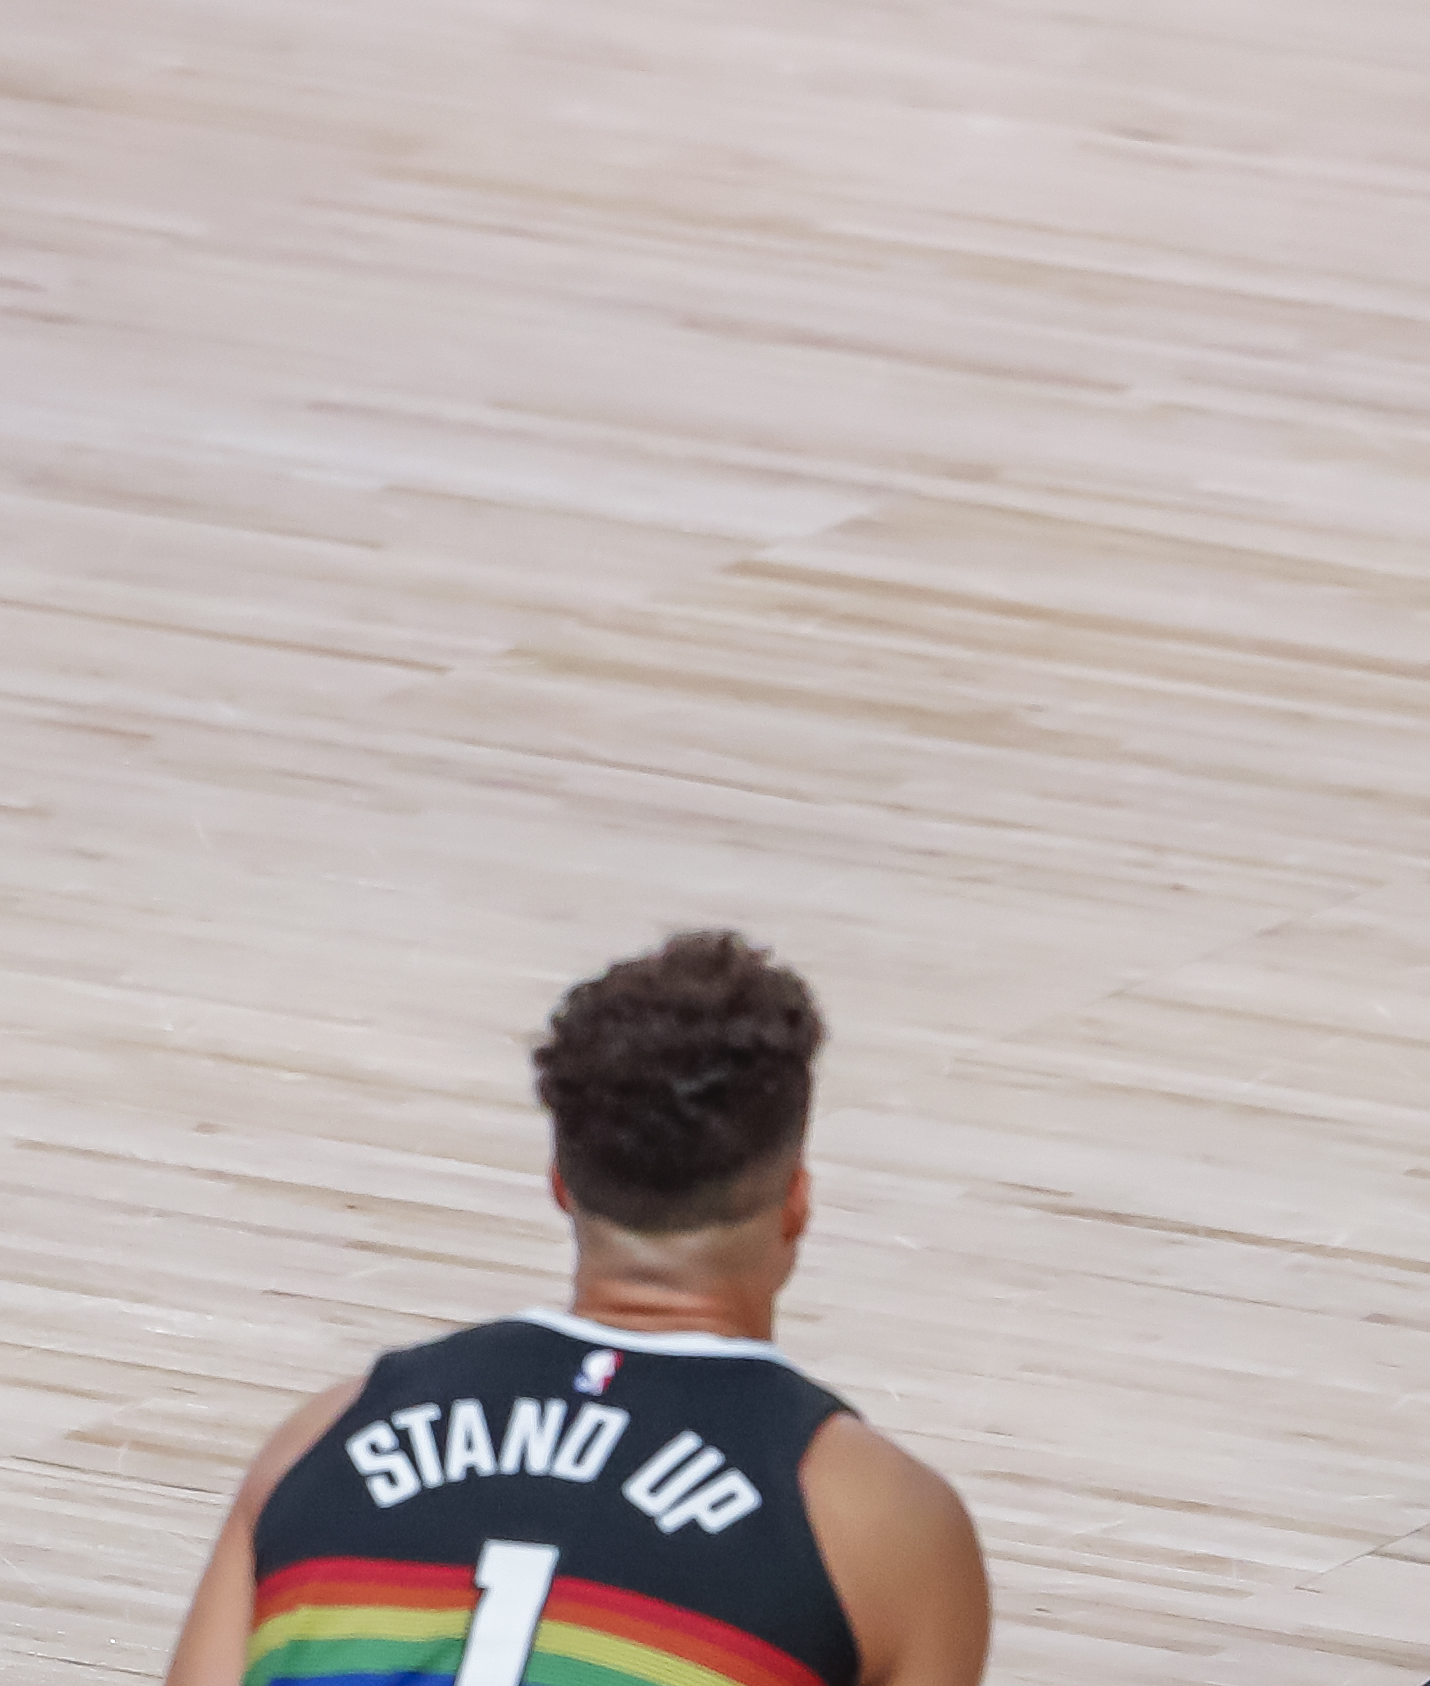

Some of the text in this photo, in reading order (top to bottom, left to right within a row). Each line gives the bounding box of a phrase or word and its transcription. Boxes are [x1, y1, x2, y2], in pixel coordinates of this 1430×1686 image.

[345, 1396, 764, 1537] STAND UP
[454, 1537, 560, 1686] 1
